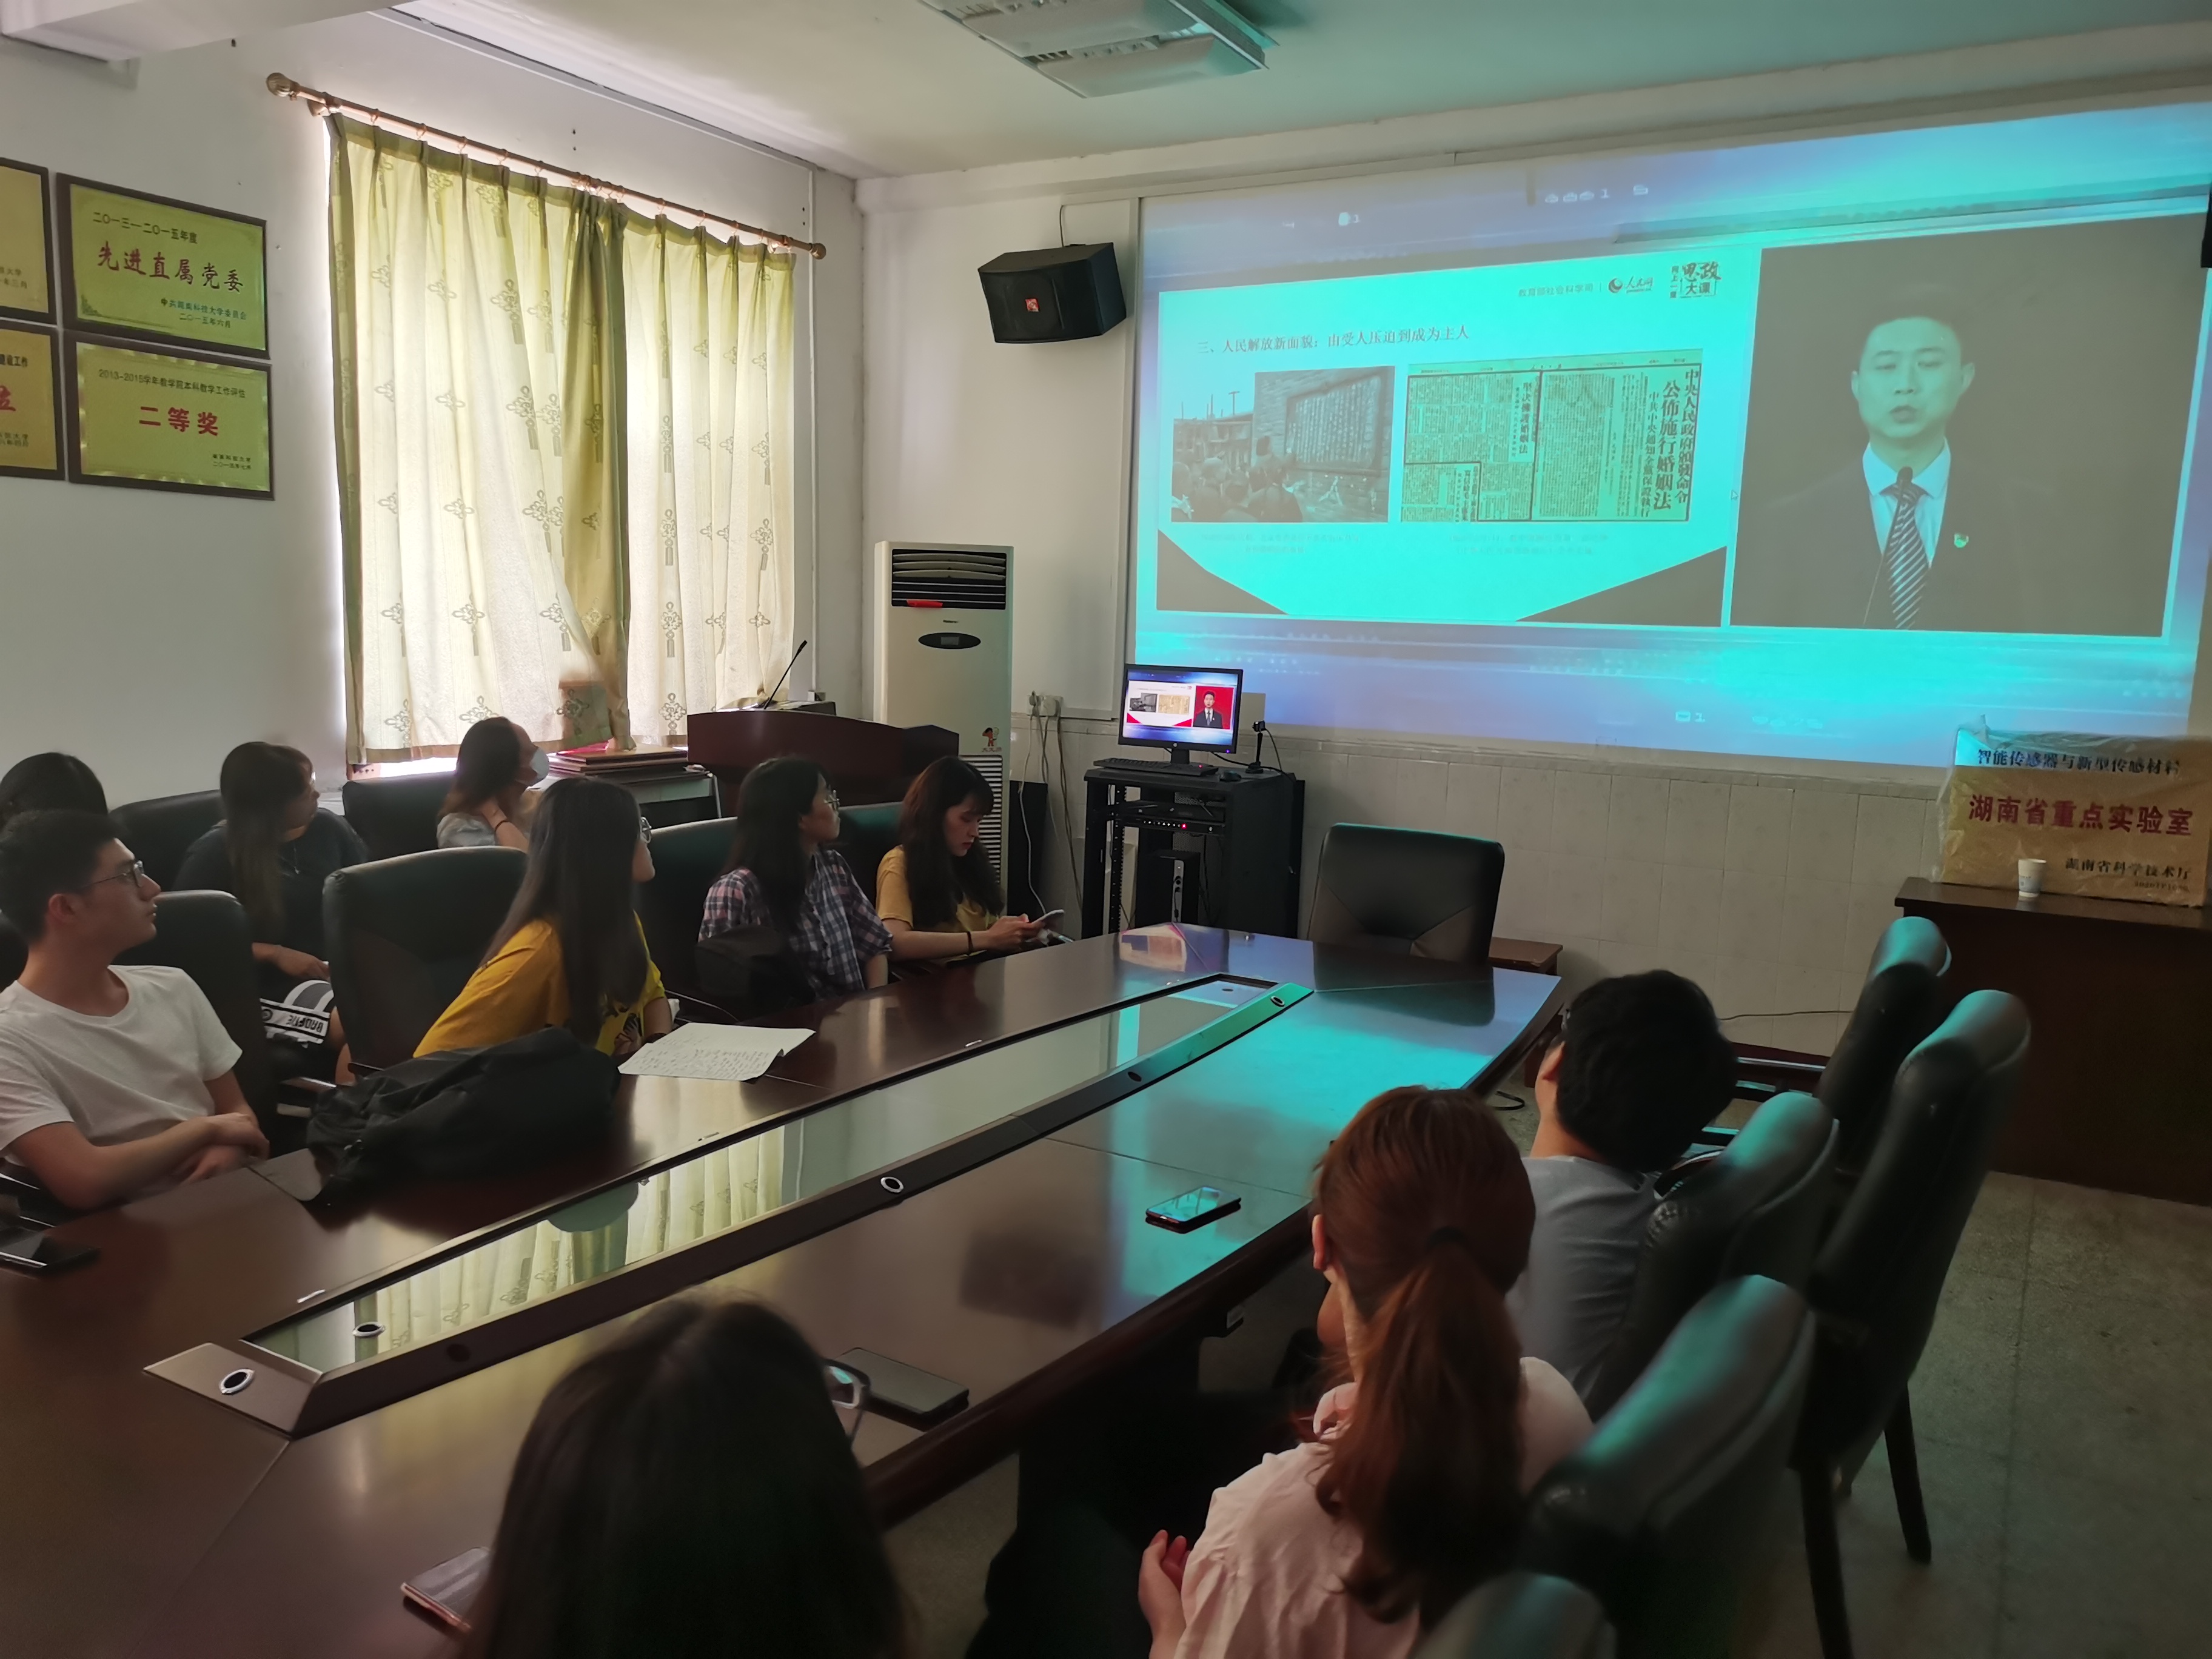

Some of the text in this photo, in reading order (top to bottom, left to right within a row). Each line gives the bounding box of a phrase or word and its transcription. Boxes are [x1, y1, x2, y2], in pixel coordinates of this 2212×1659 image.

[98, 241, 243, 293] 先进直属党委
[139, 406, 219, 437] 二等奖
[1977, 748, 2181, 776] 智能传感器与新型传感材料
[1968, 794, 2194, 837] 湖南省重点实验室
[2065, 857, 2192, 880] 湖南省科学技术厅
